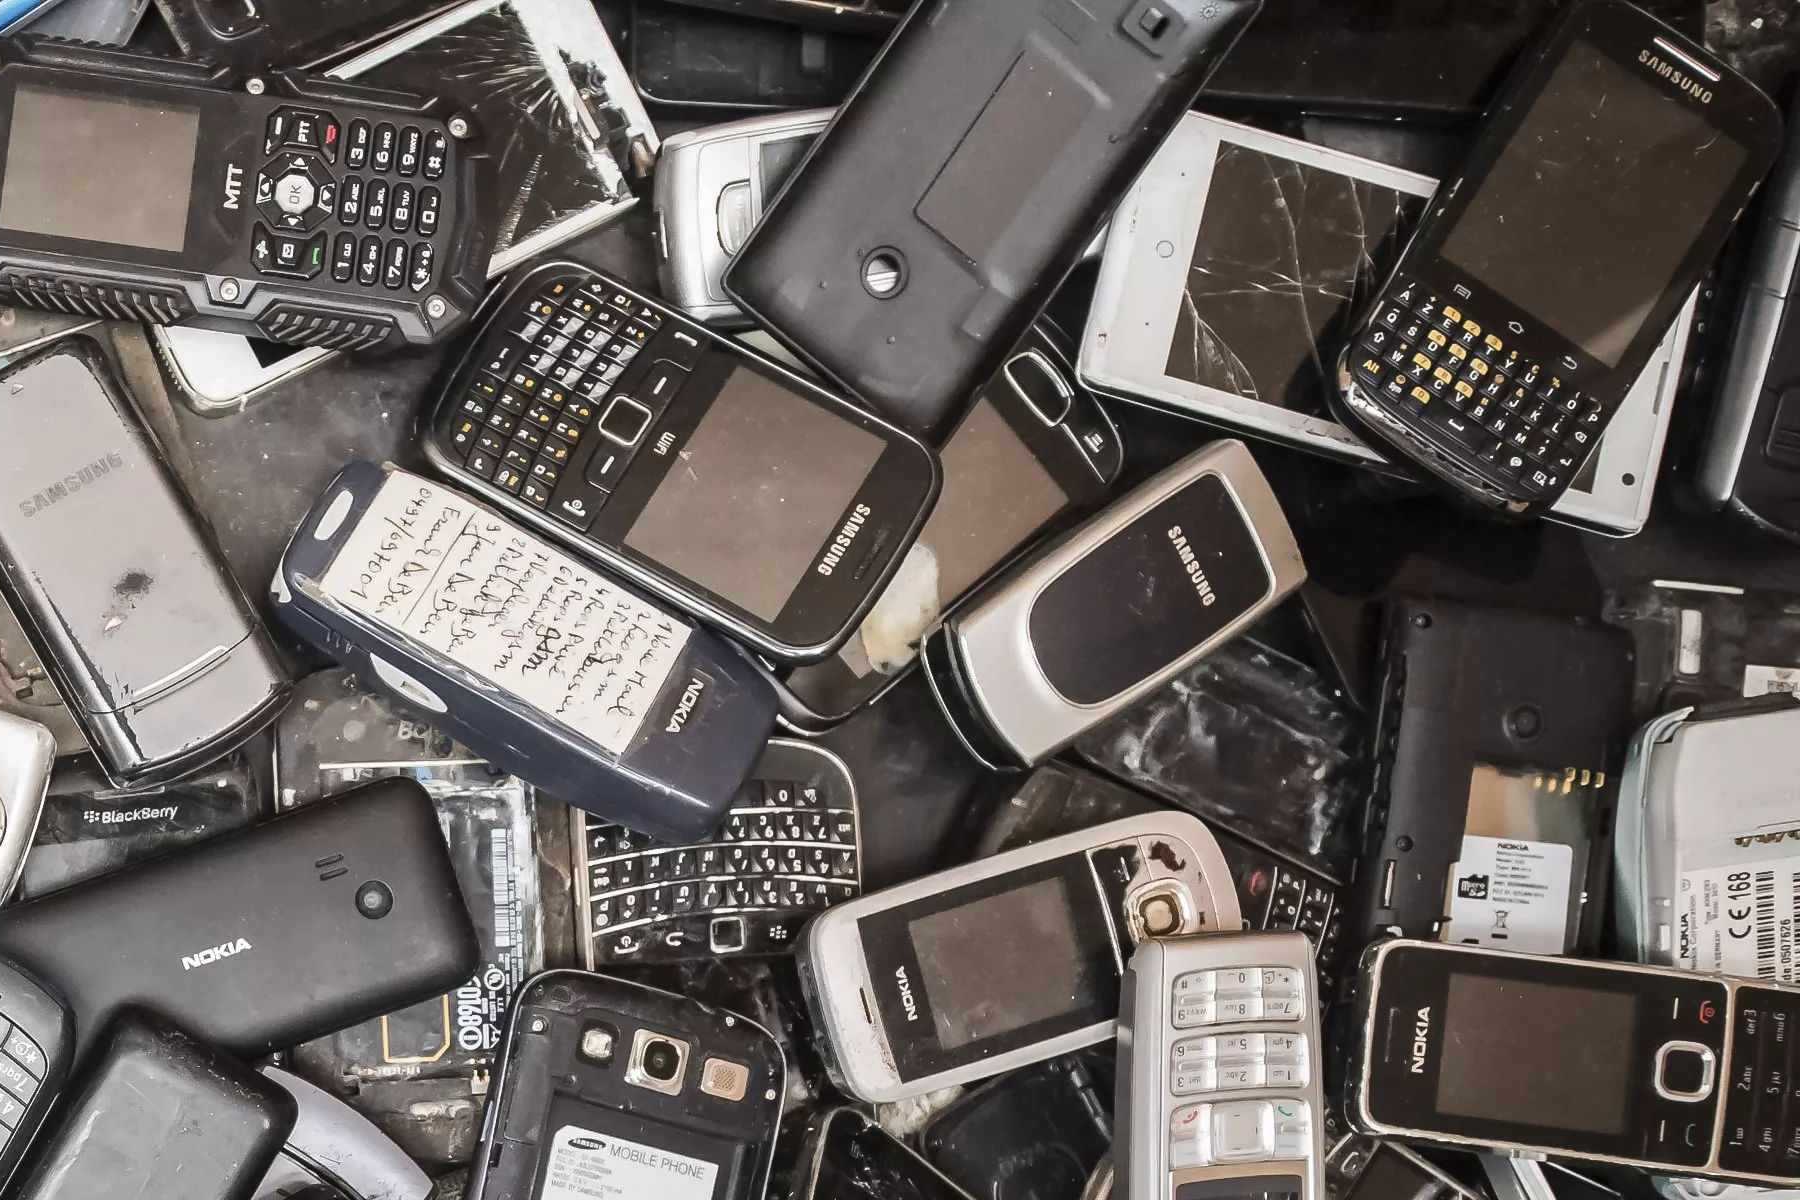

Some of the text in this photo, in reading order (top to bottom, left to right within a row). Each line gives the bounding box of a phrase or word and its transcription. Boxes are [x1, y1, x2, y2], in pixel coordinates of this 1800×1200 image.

[1638, 48, 1713, 104] SAMSUNG
[297, 120, 310, 142] PTT
[351, 147, 364, 160] 3
[376, 151, 389, 163] 6
[402, 153, 415, 166] 9
[224, 163, 244, 210] MTT
[289, 184, 302, 205] OK
[345, 201, 358, 214] 2
[396, 207, 408, 220] 8
[19, 450, 124, 519] SAMSUNG
[817, 503, 871, 576] SAMSUNG
[1167, 524, 1215, 607] SAMSUNG
[664, 676, 704, 733] NOKIA
[102, 806, 179, 825] BlackBerry
[1497, 842, 1529, 851] NOKIA
[1727, 872, 1751, 901] 168
[1680, 913, 1689, 959] NOKIA
[181, 937, 252, 971] NOKIA
[895, 965, 918, 1021] NOKIA
[1411, 1006, 1431, 1074] NOKIA
[609, 1144, 705, 1179] MOBILE PHONE
